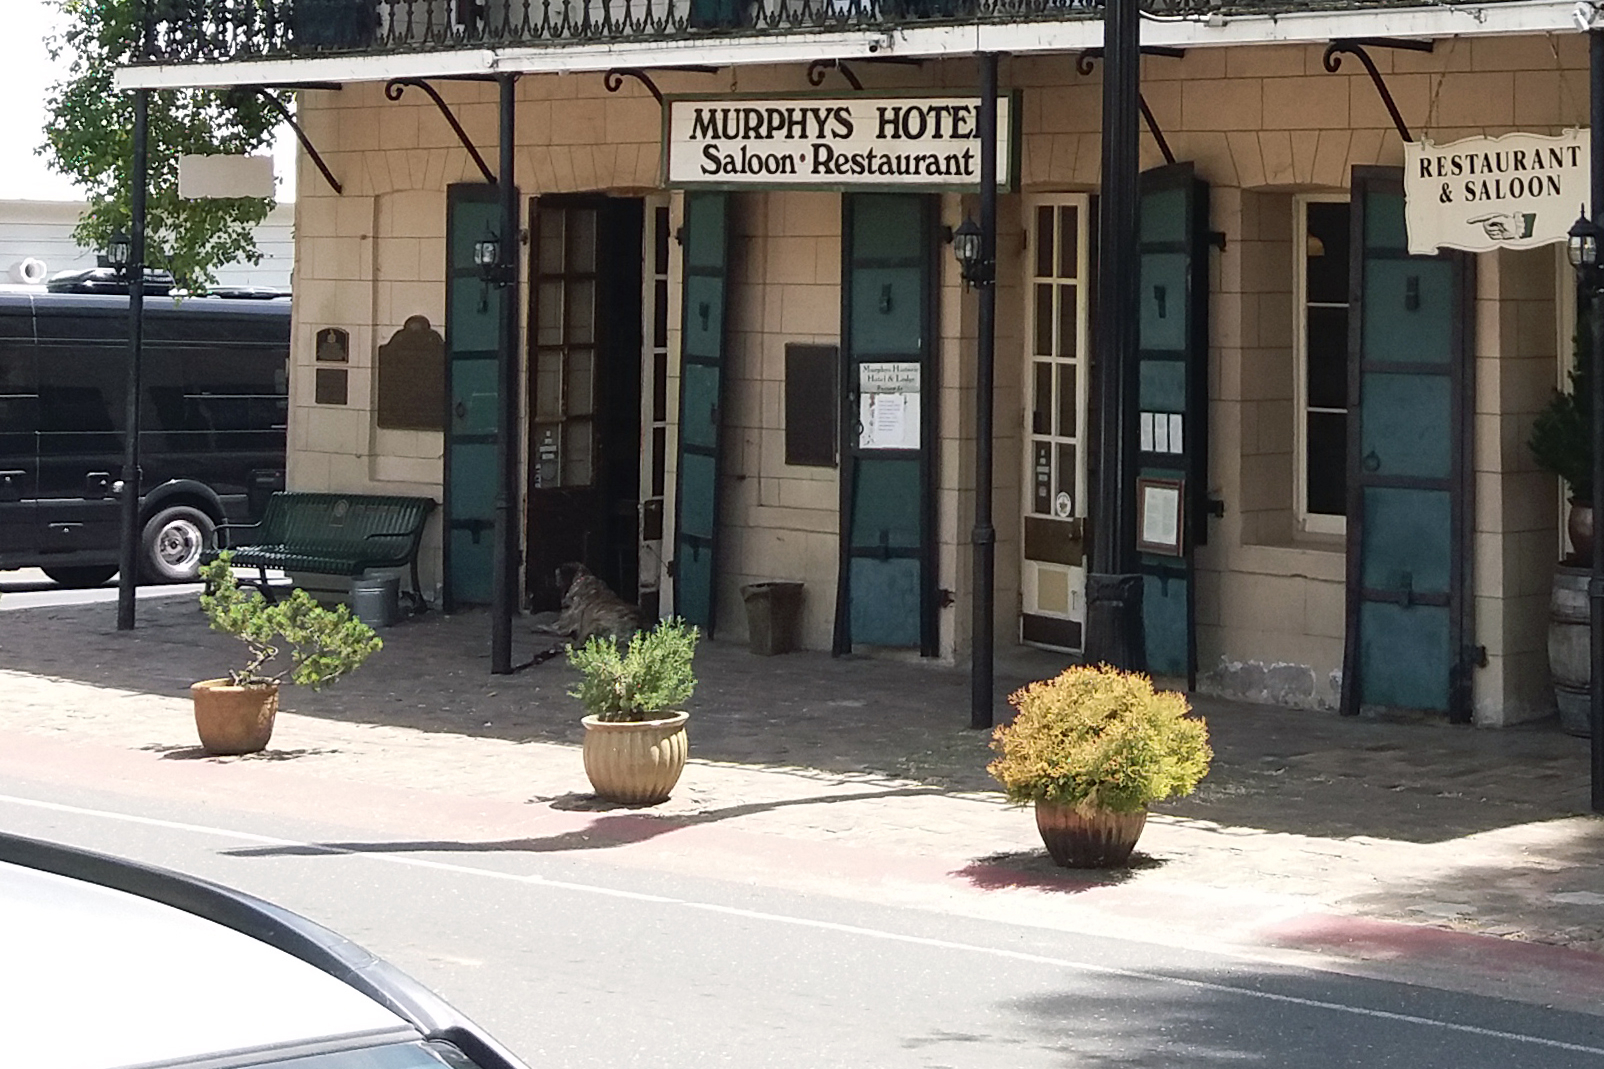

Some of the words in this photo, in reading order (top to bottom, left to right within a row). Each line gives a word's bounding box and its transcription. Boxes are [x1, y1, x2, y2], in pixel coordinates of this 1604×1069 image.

[689, 105, 854, 141] MURPHYS
[700, 143, 797, 175] Saloon
[811, 143, 975, 176] Restaurant
[1419, 145, 1582, 179] RESTAURANT
[1439, 182, 1453, 203] &
[1464, 174, 1561, 202] SALOON
